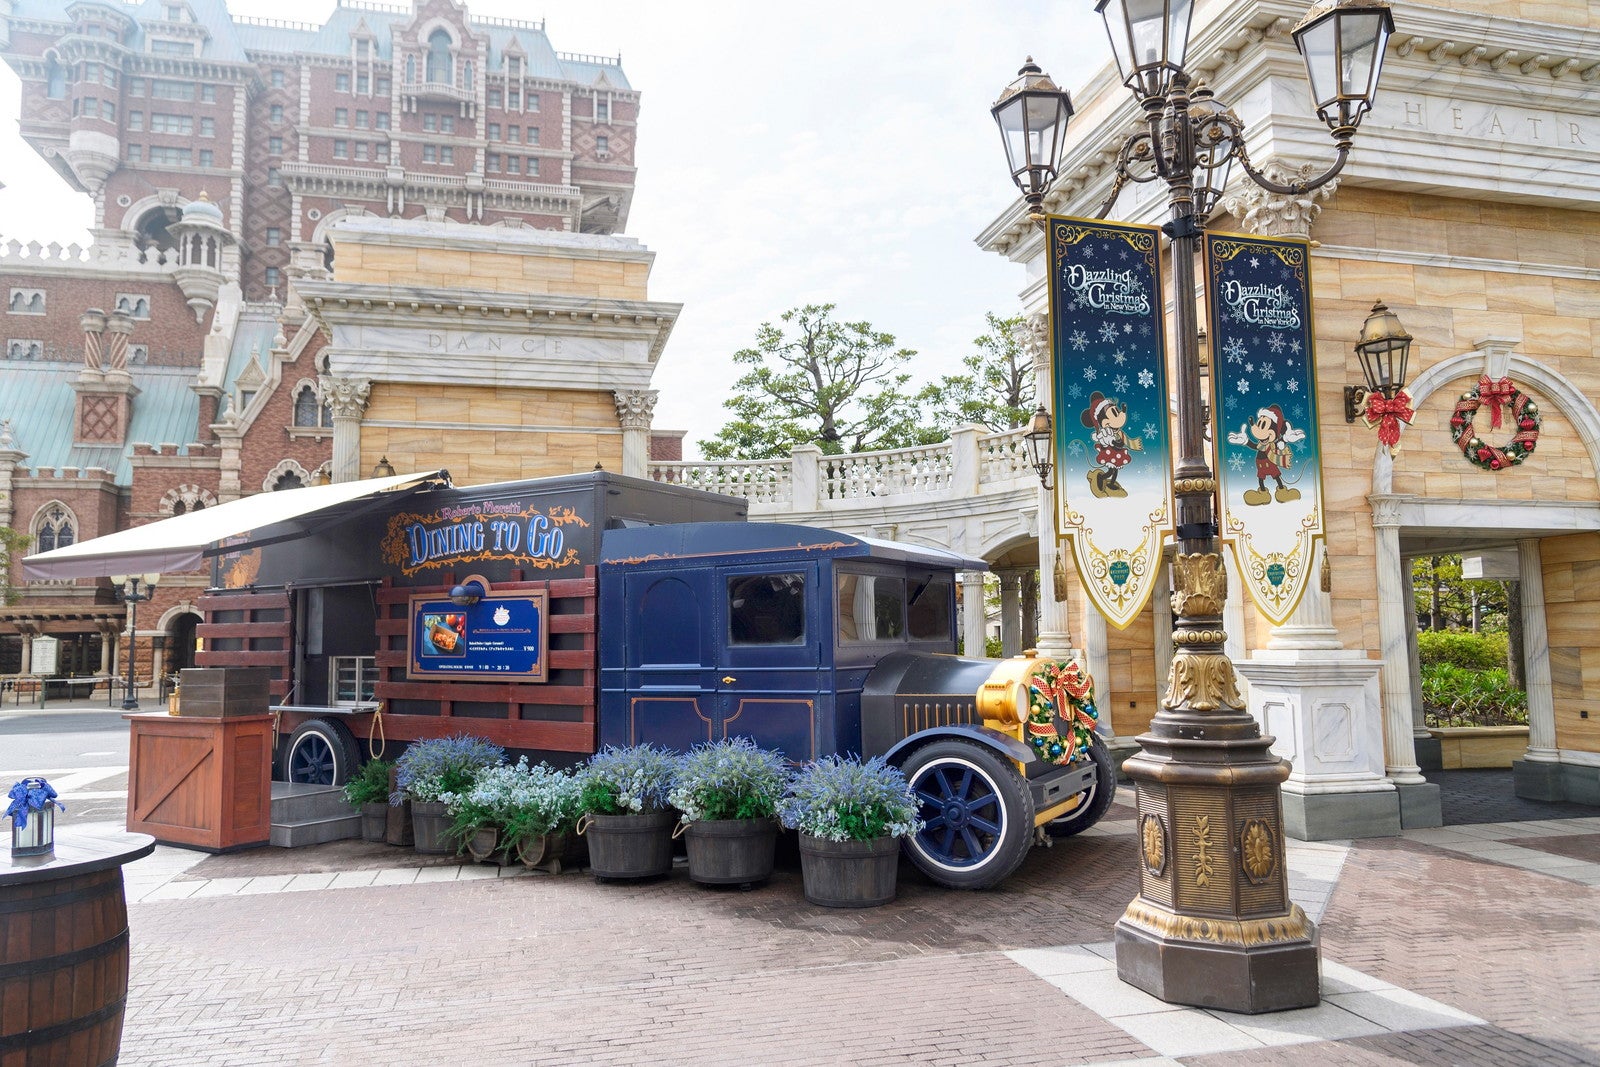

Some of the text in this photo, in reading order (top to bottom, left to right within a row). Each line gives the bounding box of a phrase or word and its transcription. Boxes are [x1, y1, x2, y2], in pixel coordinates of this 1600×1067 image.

[1365, 101, 1586, 145] HEATR
[1067, 264, 1131, 295] Dazzling
[1224, 280, 1283, 309] Dazzling
[1088, 283, 1150, 315] Christmas
[1244, 298, 1301, 329] Christmas
[428, 334, 562, 354] DANCE
[441, 504, 482, 520] Roberto
[406, 522, 486, 566] DINING
[490, 521, 521, 551] TO
